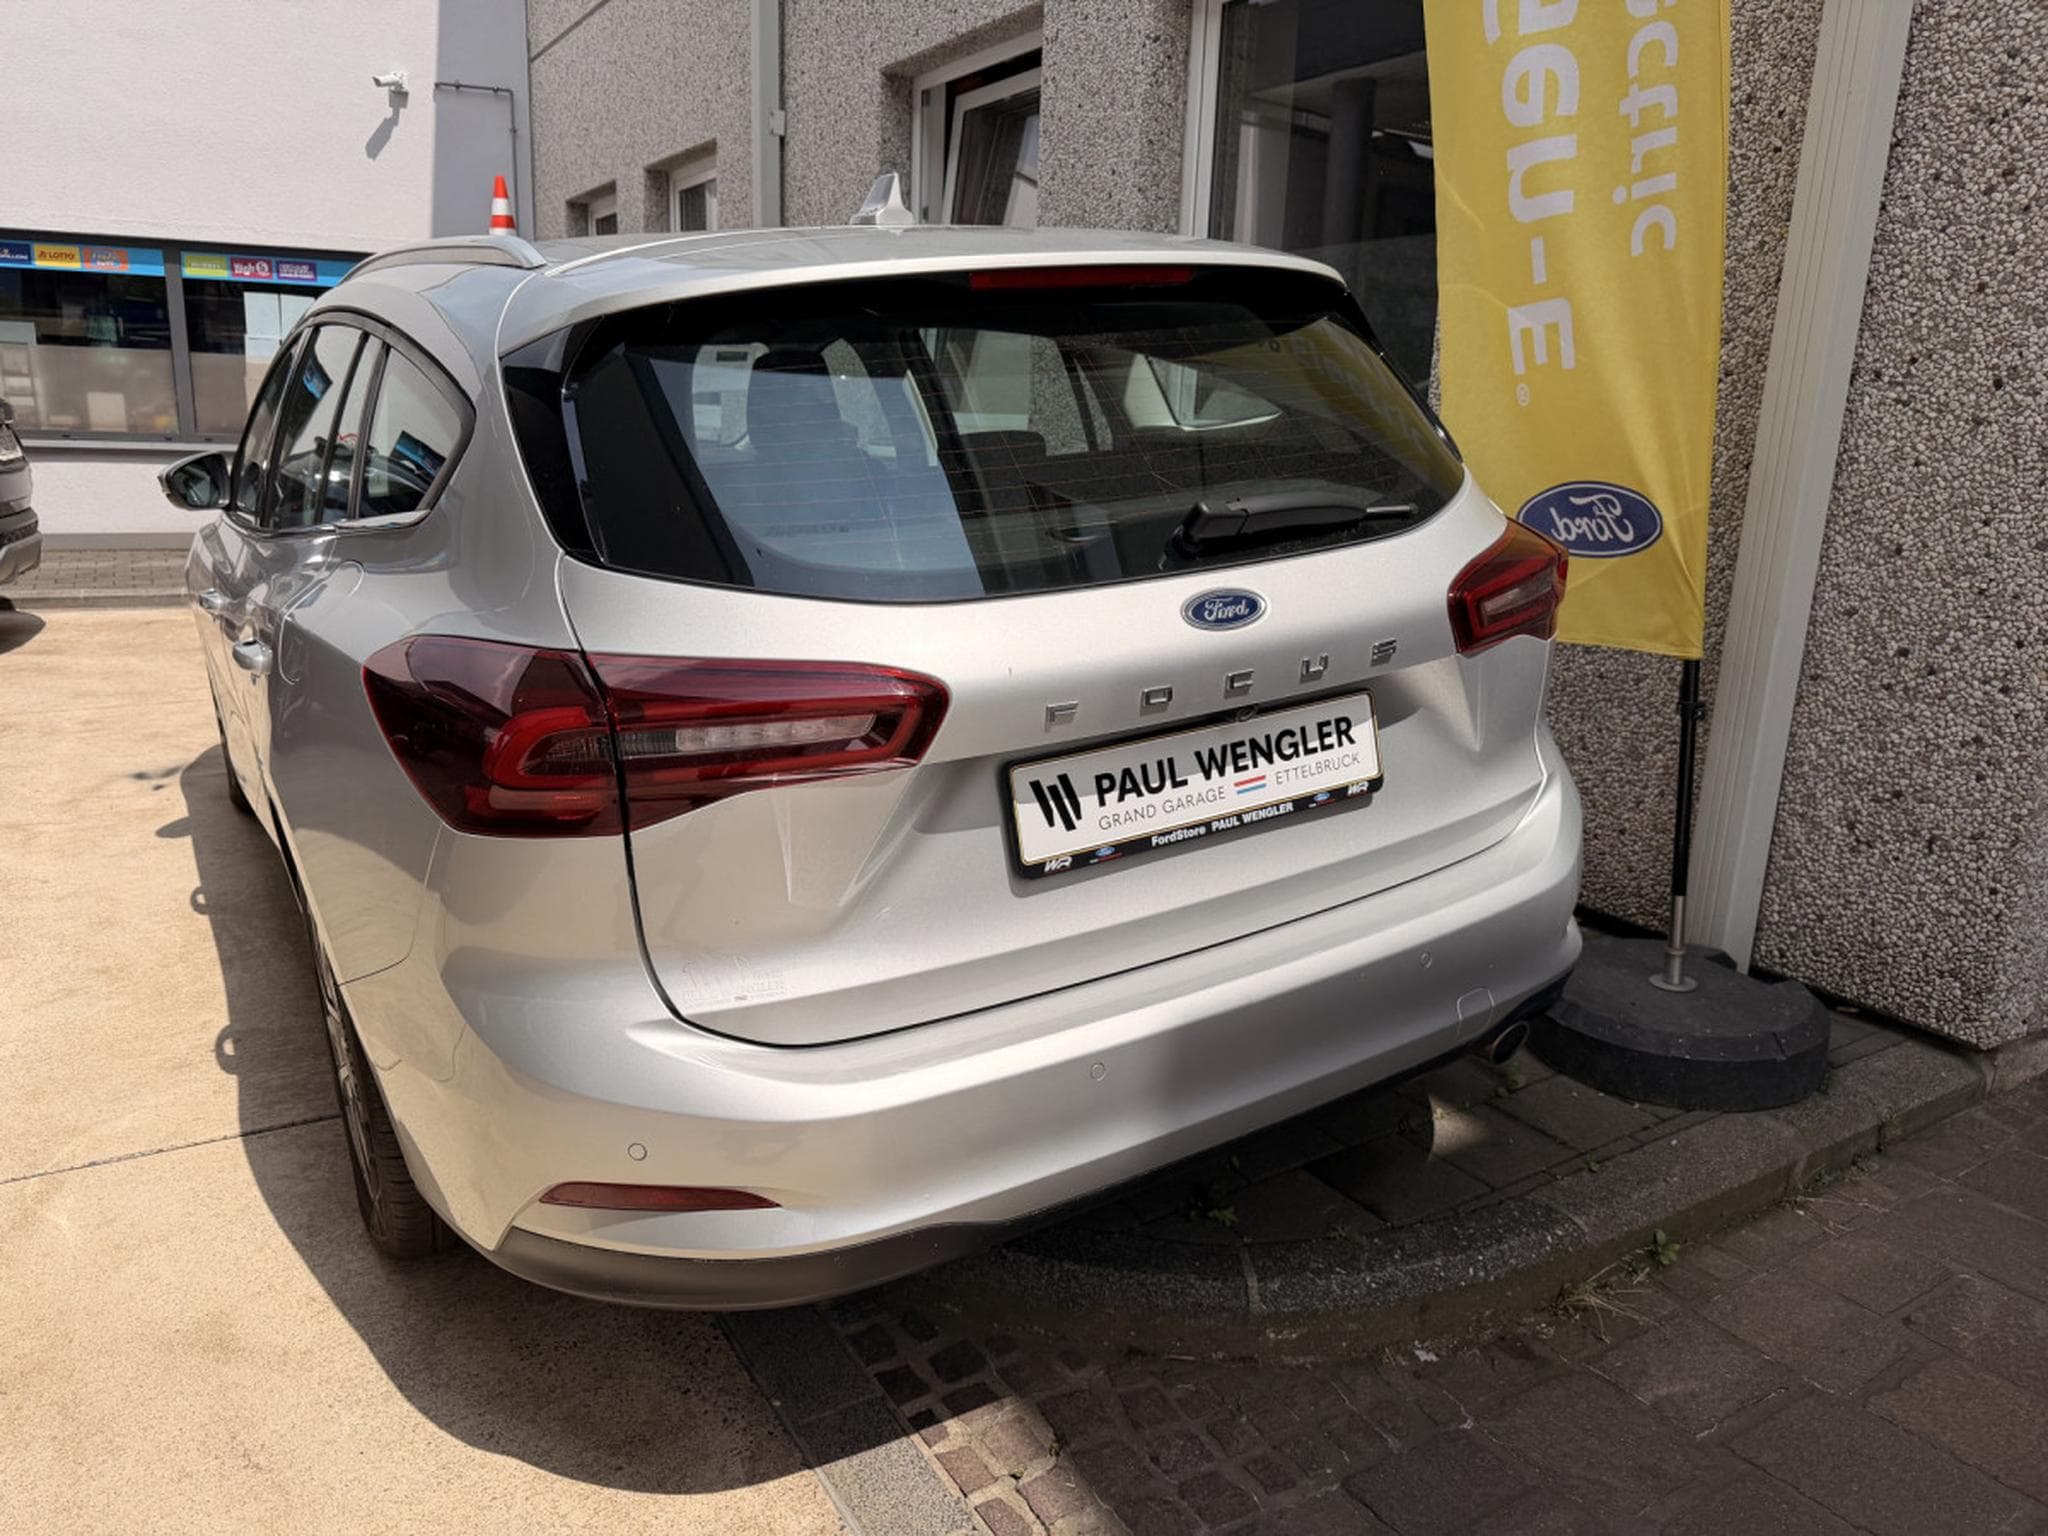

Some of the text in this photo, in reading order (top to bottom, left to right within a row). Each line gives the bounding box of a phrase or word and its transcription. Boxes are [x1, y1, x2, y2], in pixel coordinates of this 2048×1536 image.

[1203, 597, 1250, 621] Ford
[1045, 639, 1397, 727] FOCUS
[1094, 716, 1356, 808] PAUL WENGLER
[1098, 752, 1361, 831] GRAND GARAGE ETTELBRUCK
[1151, 801, 1295, 848] FordStore PAUL WENGLER
